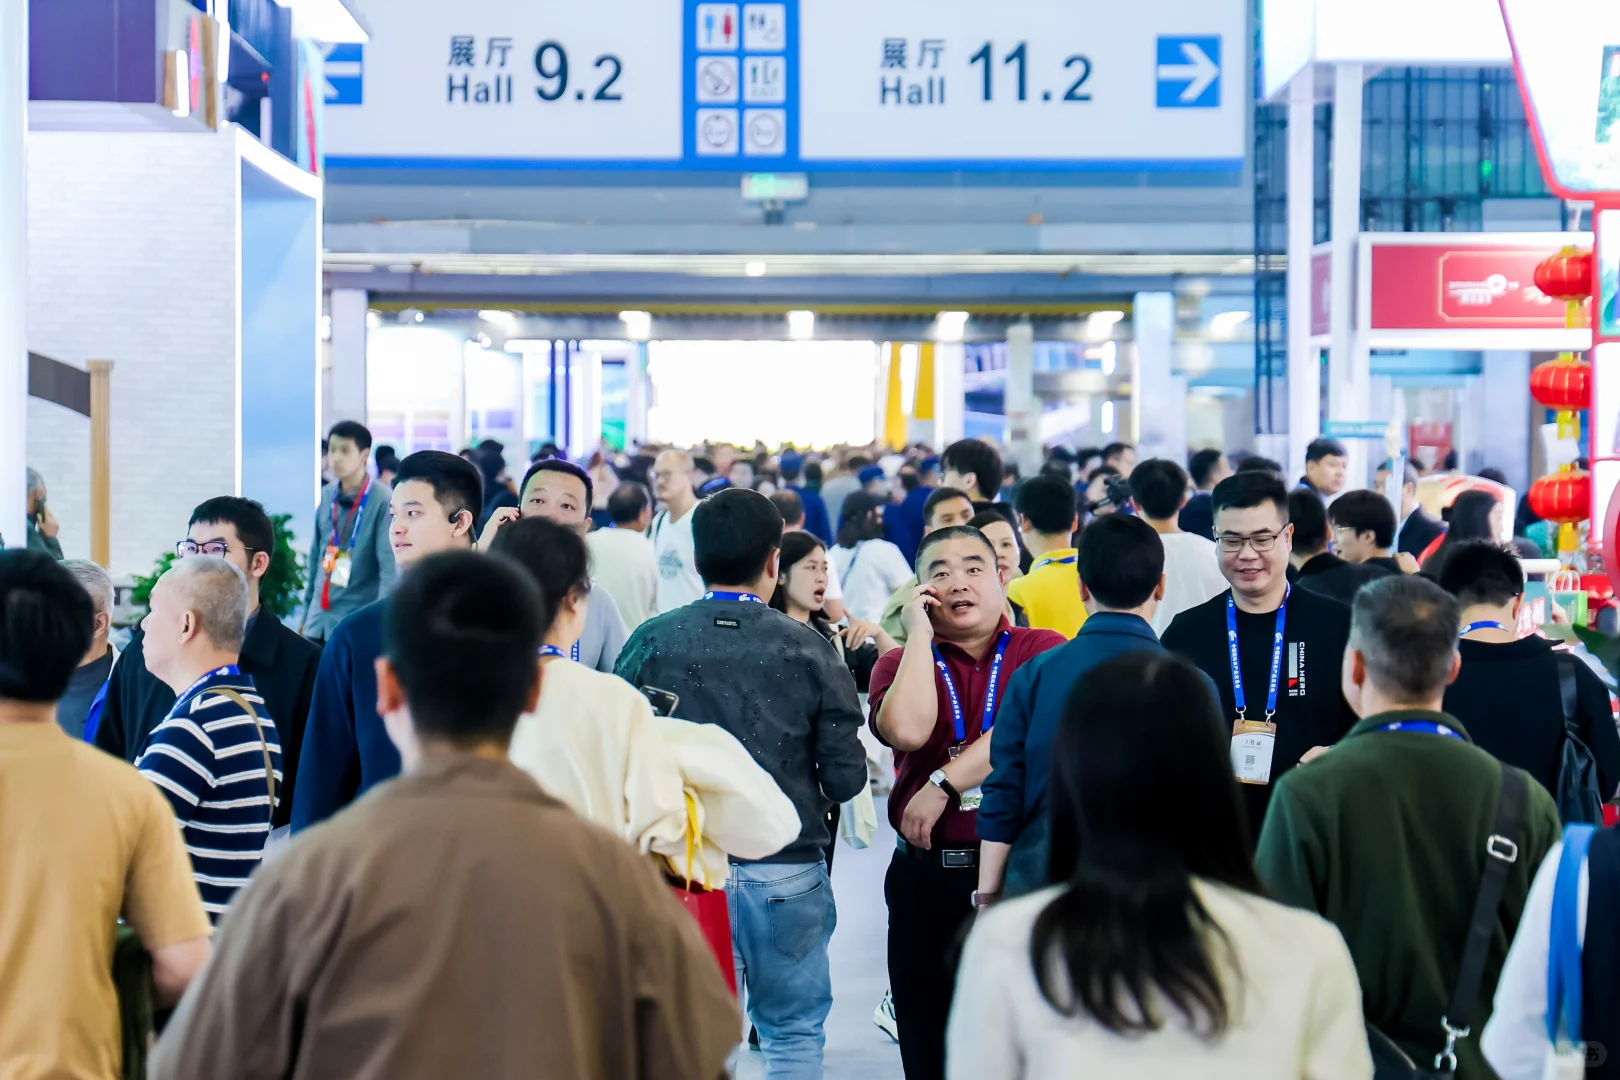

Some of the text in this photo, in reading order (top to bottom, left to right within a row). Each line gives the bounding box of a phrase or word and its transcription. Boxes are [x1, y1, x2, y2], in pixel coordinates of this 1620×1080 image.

[448, 35, 513, 67] 展厅
[448, 40, 622, 103] Hall 9.2
[881, 37, 945, 68] 展厅
[881, 41, 1092, 104] Hall 11.2
